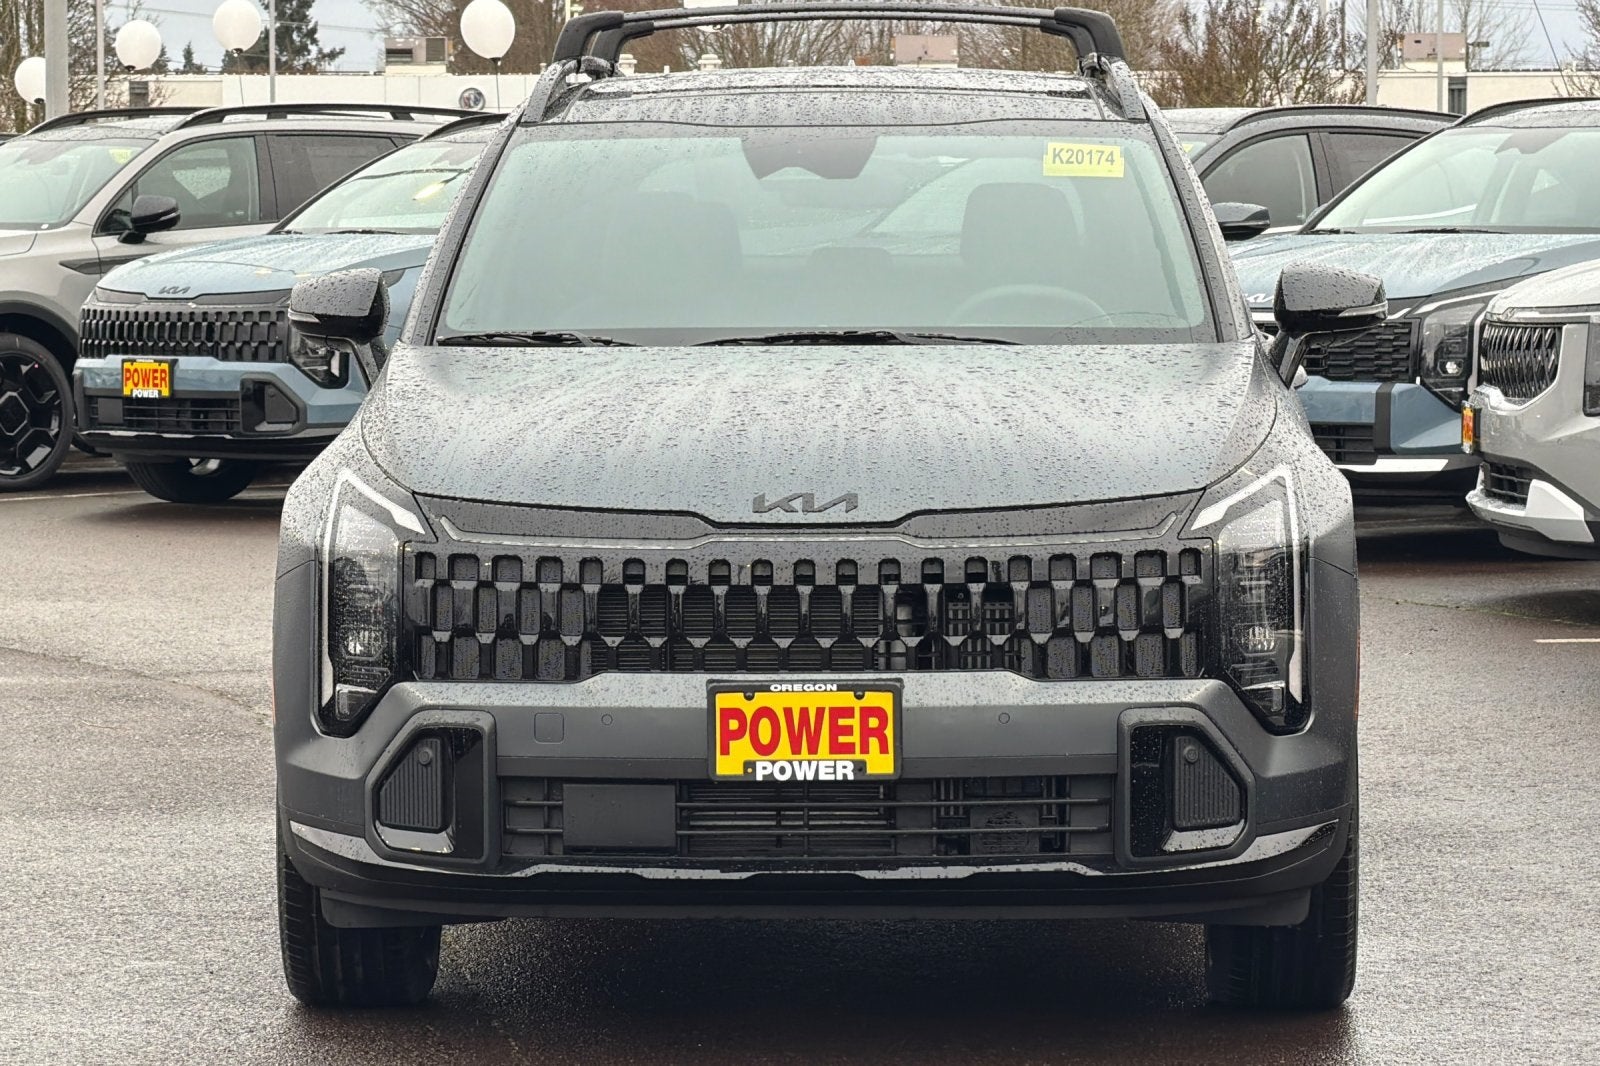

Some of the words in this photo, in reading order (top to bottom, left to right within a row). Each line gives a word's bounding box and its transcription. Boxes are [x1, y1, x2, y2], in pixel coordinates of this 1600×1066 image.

[1051, 147, 1115, 166] K20174
[124, 367, 168, 389] POWER
[132, 389, 159, 399] POWER
[752, 492, 859, 513] KIA
[769, 683, 838, 692] OREGON
[719, 706, 890, 756] POWER
[755, 760, 855, 781] POWER
